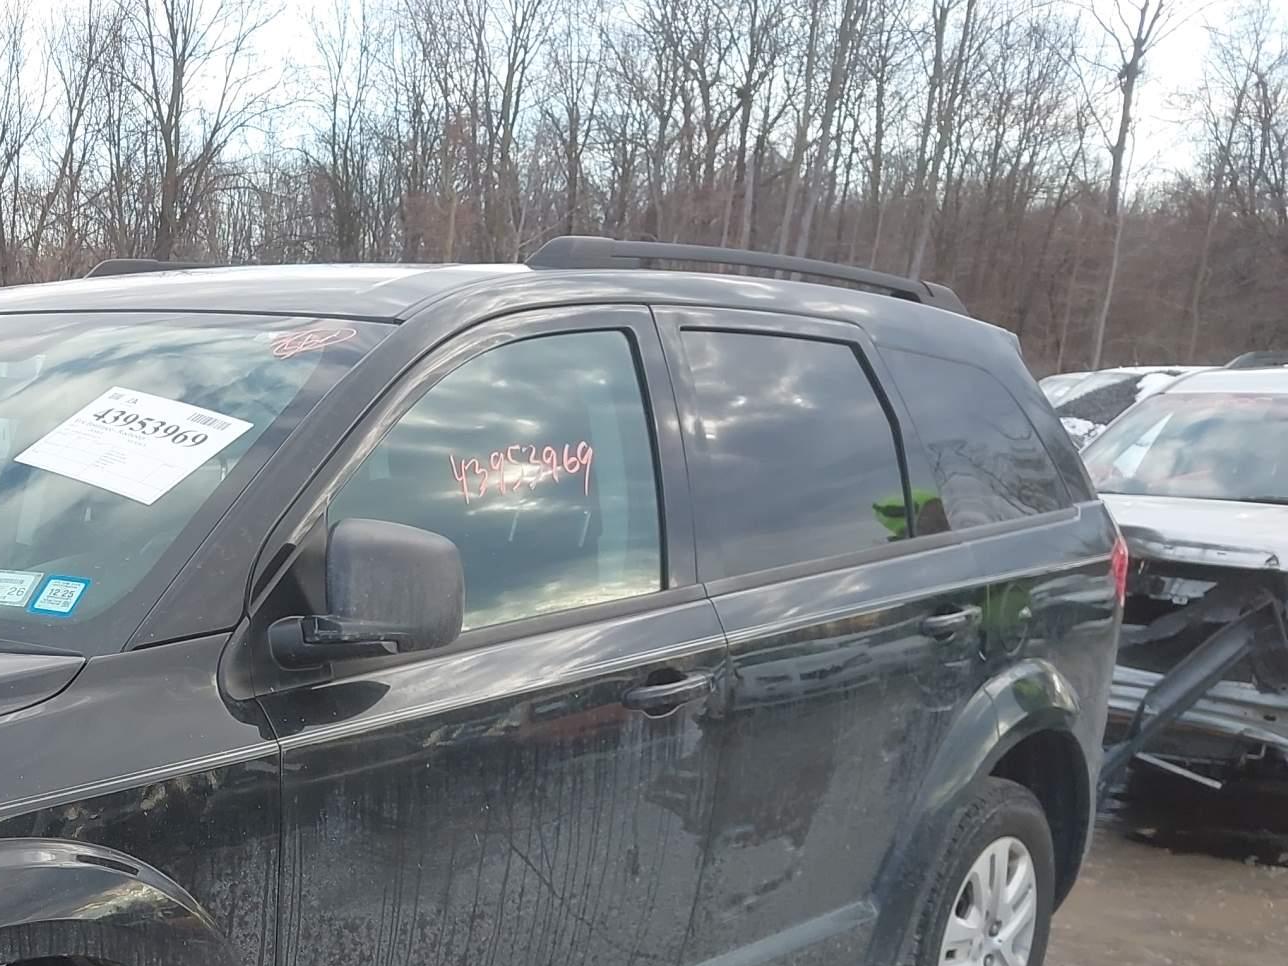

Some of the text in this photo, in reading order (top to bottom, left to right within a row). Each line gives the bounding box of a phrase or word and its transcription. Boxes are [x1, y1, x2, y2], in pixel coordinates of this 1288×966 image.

[92, 407, 209, 448] 43953969
[449, 440, 593, 505] 43953969
[7, 586, 26, 597] 26
